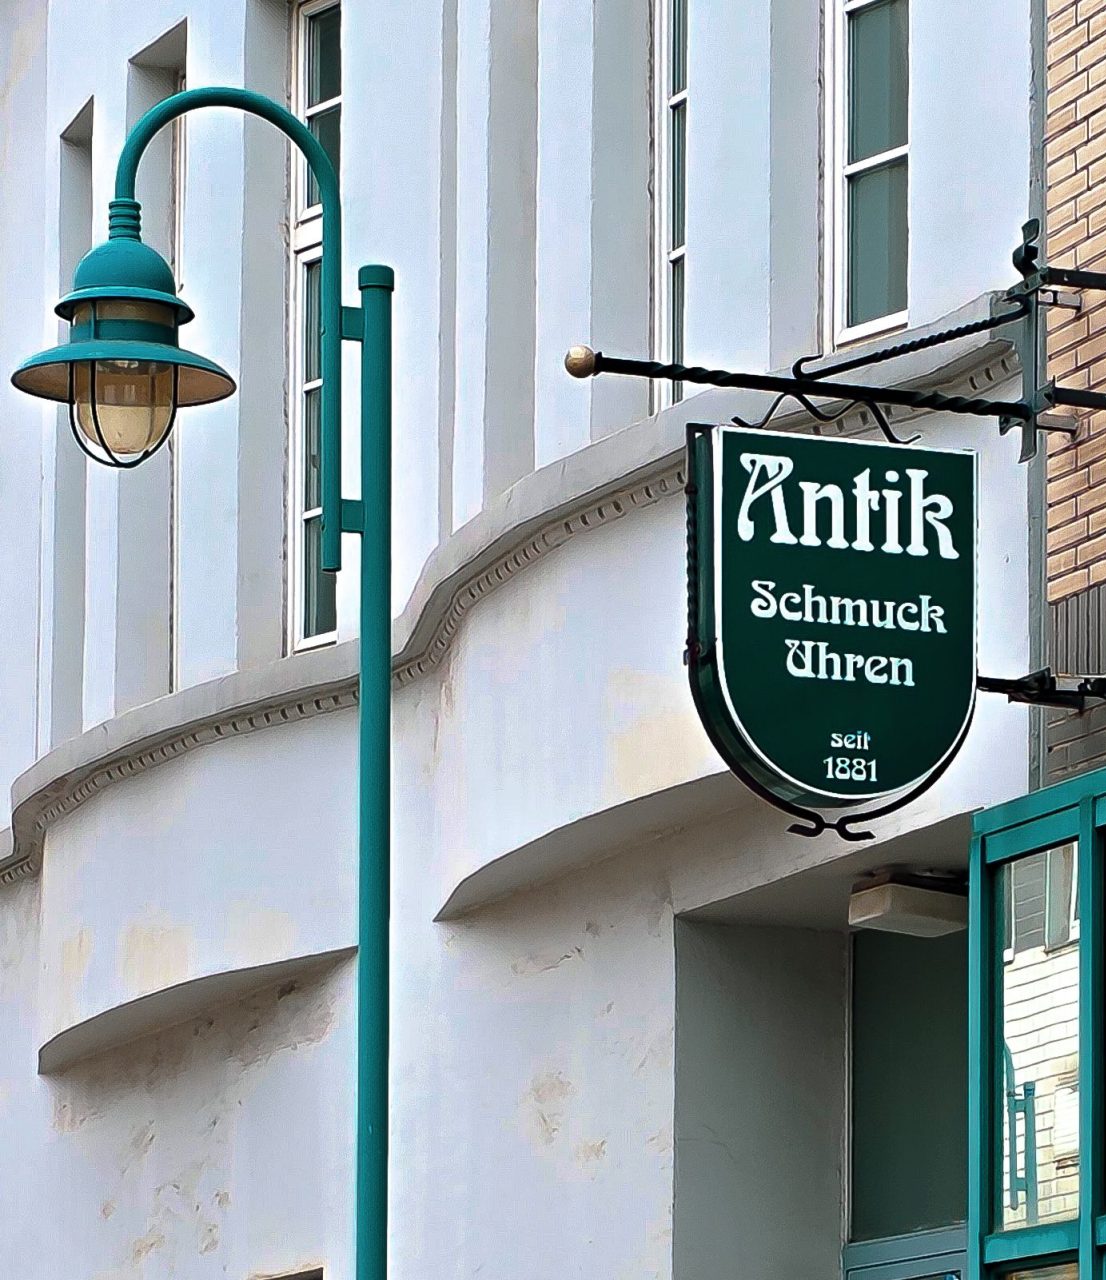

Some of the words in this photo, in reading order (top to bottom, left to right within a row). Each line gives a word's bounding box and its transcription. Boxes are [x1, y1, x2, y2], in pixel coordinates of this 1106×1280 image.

[737, 453, 960, 560] Antik
[750, 580, 948, 634] Schmuck
[785, 639, 915, 687] Uhren
[830, 730, 871, 751] seit
[823, 757, 878, 782] 1881
